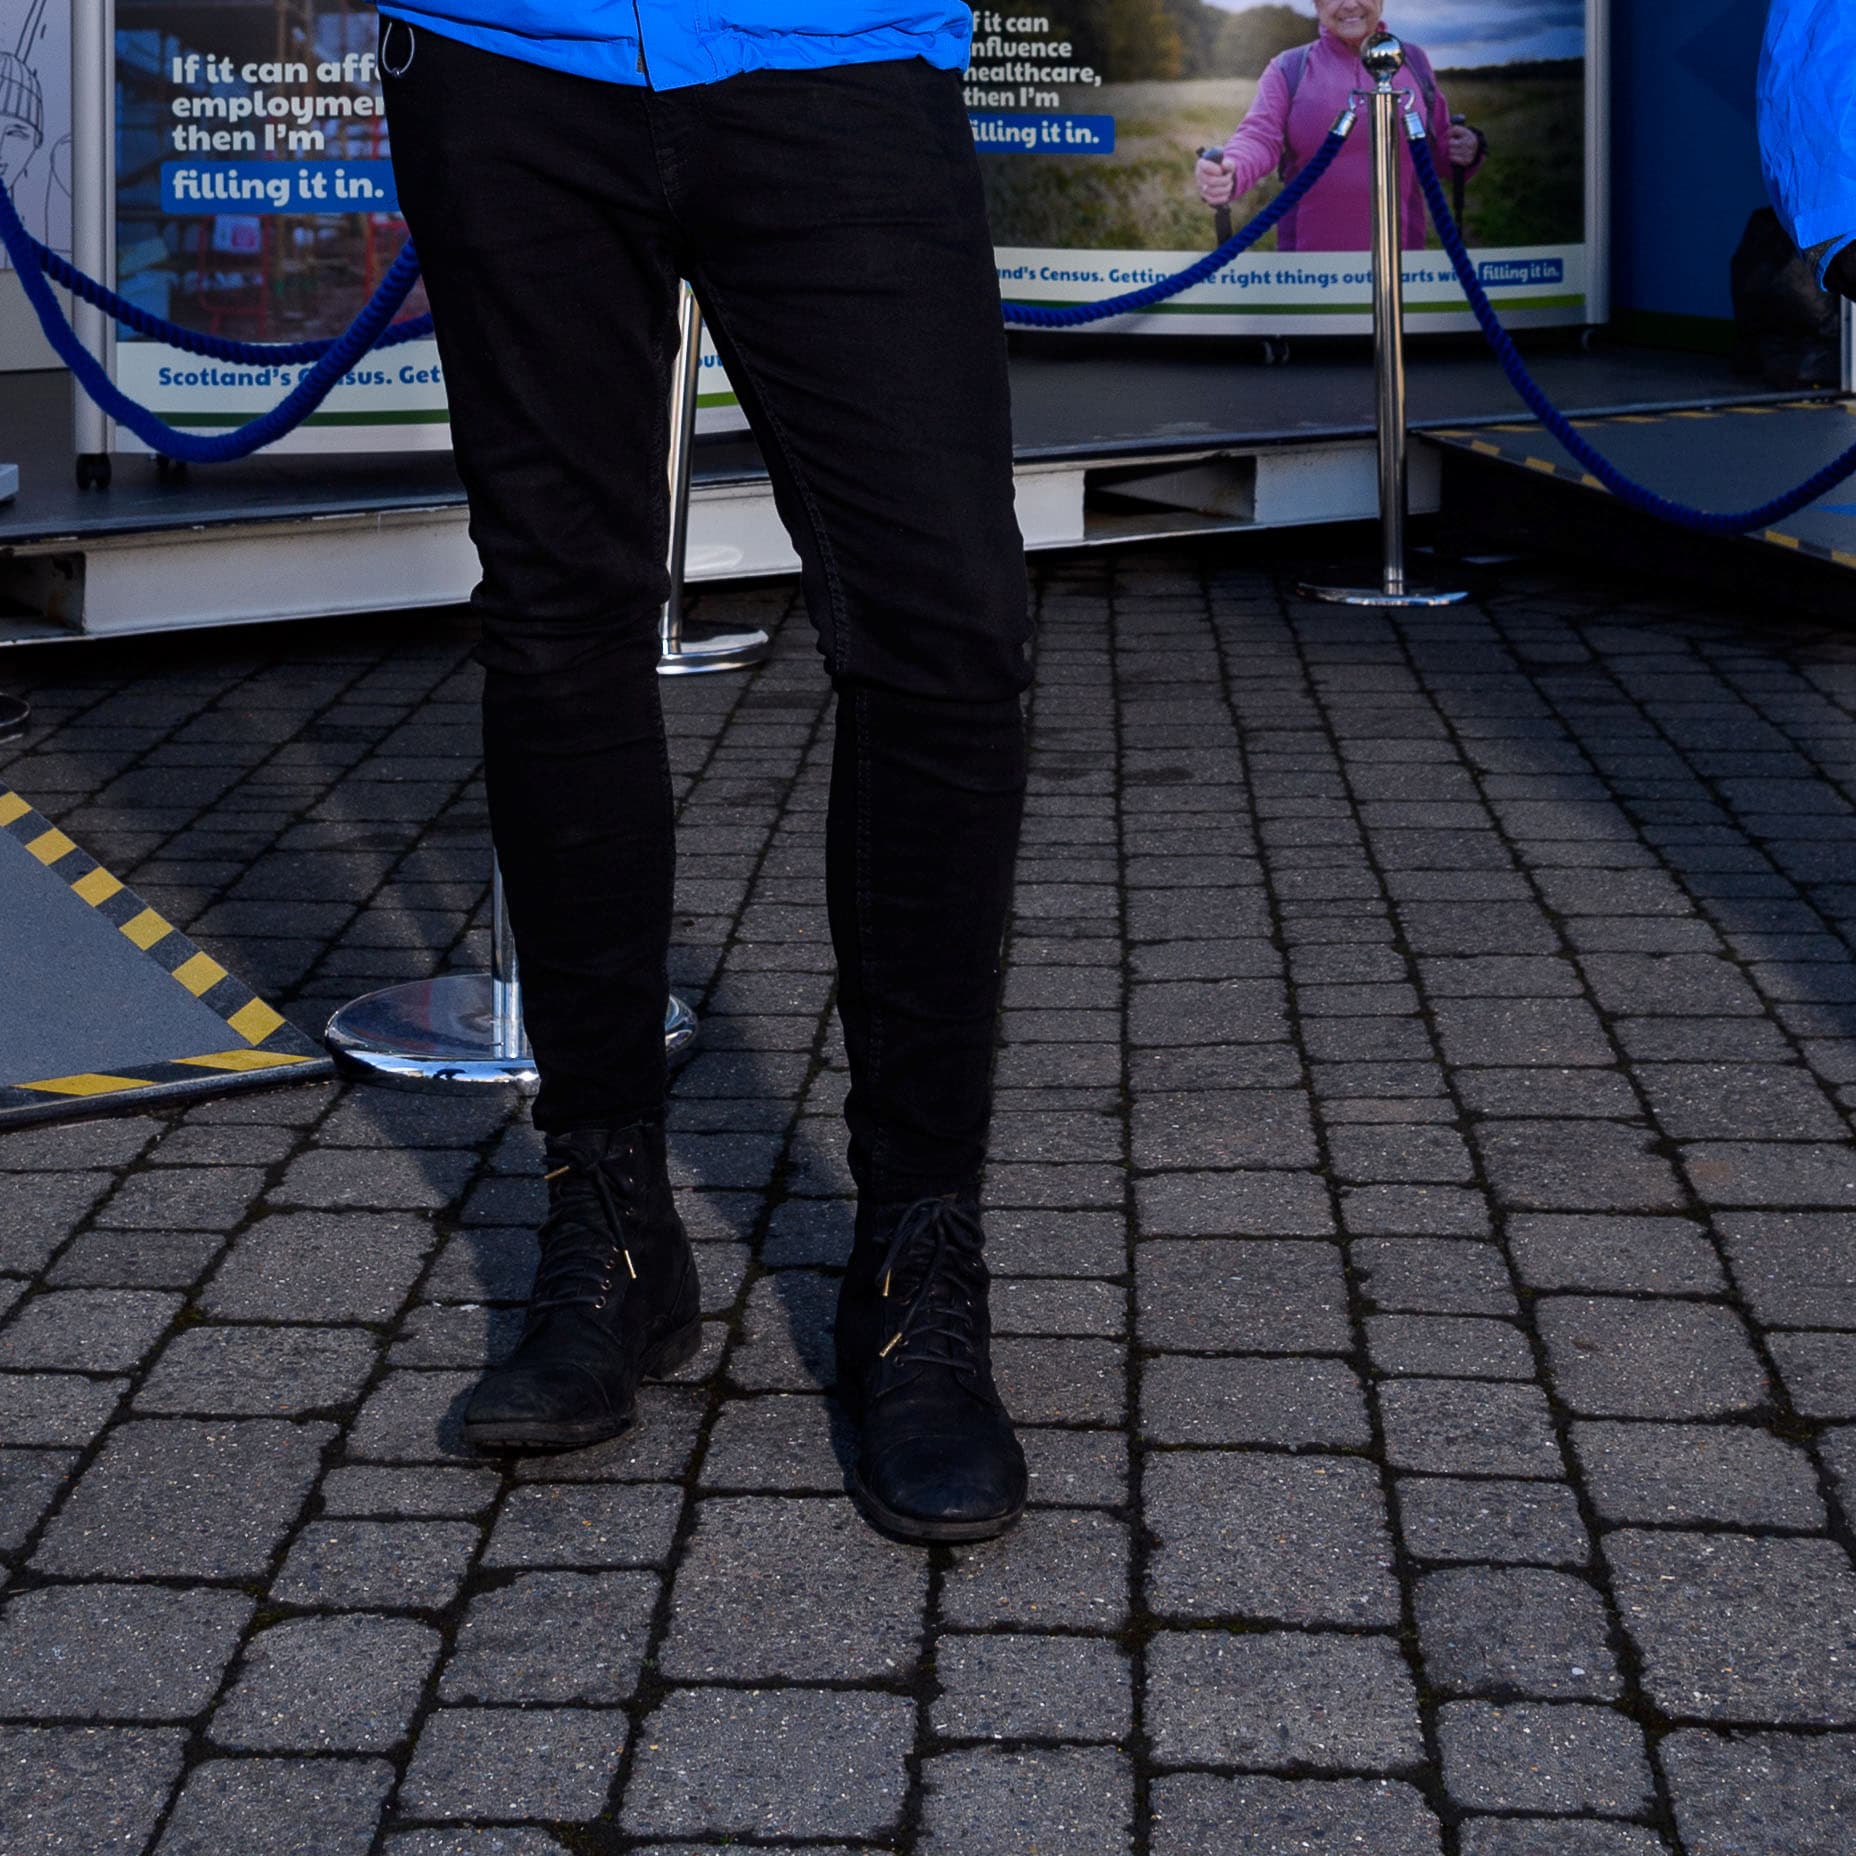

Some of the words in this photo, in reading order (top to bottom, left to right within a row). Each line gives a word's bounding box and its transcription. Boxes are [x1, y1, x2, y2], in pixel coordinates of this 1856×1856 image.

[984, 11, 1001, 32] it
[1005, 17, 1049, 33] can
[970, 36, 1073, 58] nfluence
[172, 54, 200, 84] If
[206, 54, 234, 84] it
[241, 62, 308, 84] can
[963, 62, 1102, 87] healthcare,
[963, 86, 1015, 107] then
[1020, 86, 1060, 107] I'm
[172, 124, 256, 151] then
[264, 124, 325, 151] I'm
[1041, 120, 1061, 143] it
[1065, 121, 1100, 144] in.
[173, 169, 291, 207] filling
[299, 169, 327, 199] it
[335, 168, 385, 199] in.
[1039, 267, 1105, 282] Census.
[1221, 270, 1271, 288] right
[1276, 270, 1338, 288] things
[1482, 264, 1529, 282] filling
[158, 366, 292, 387] Scotland's
